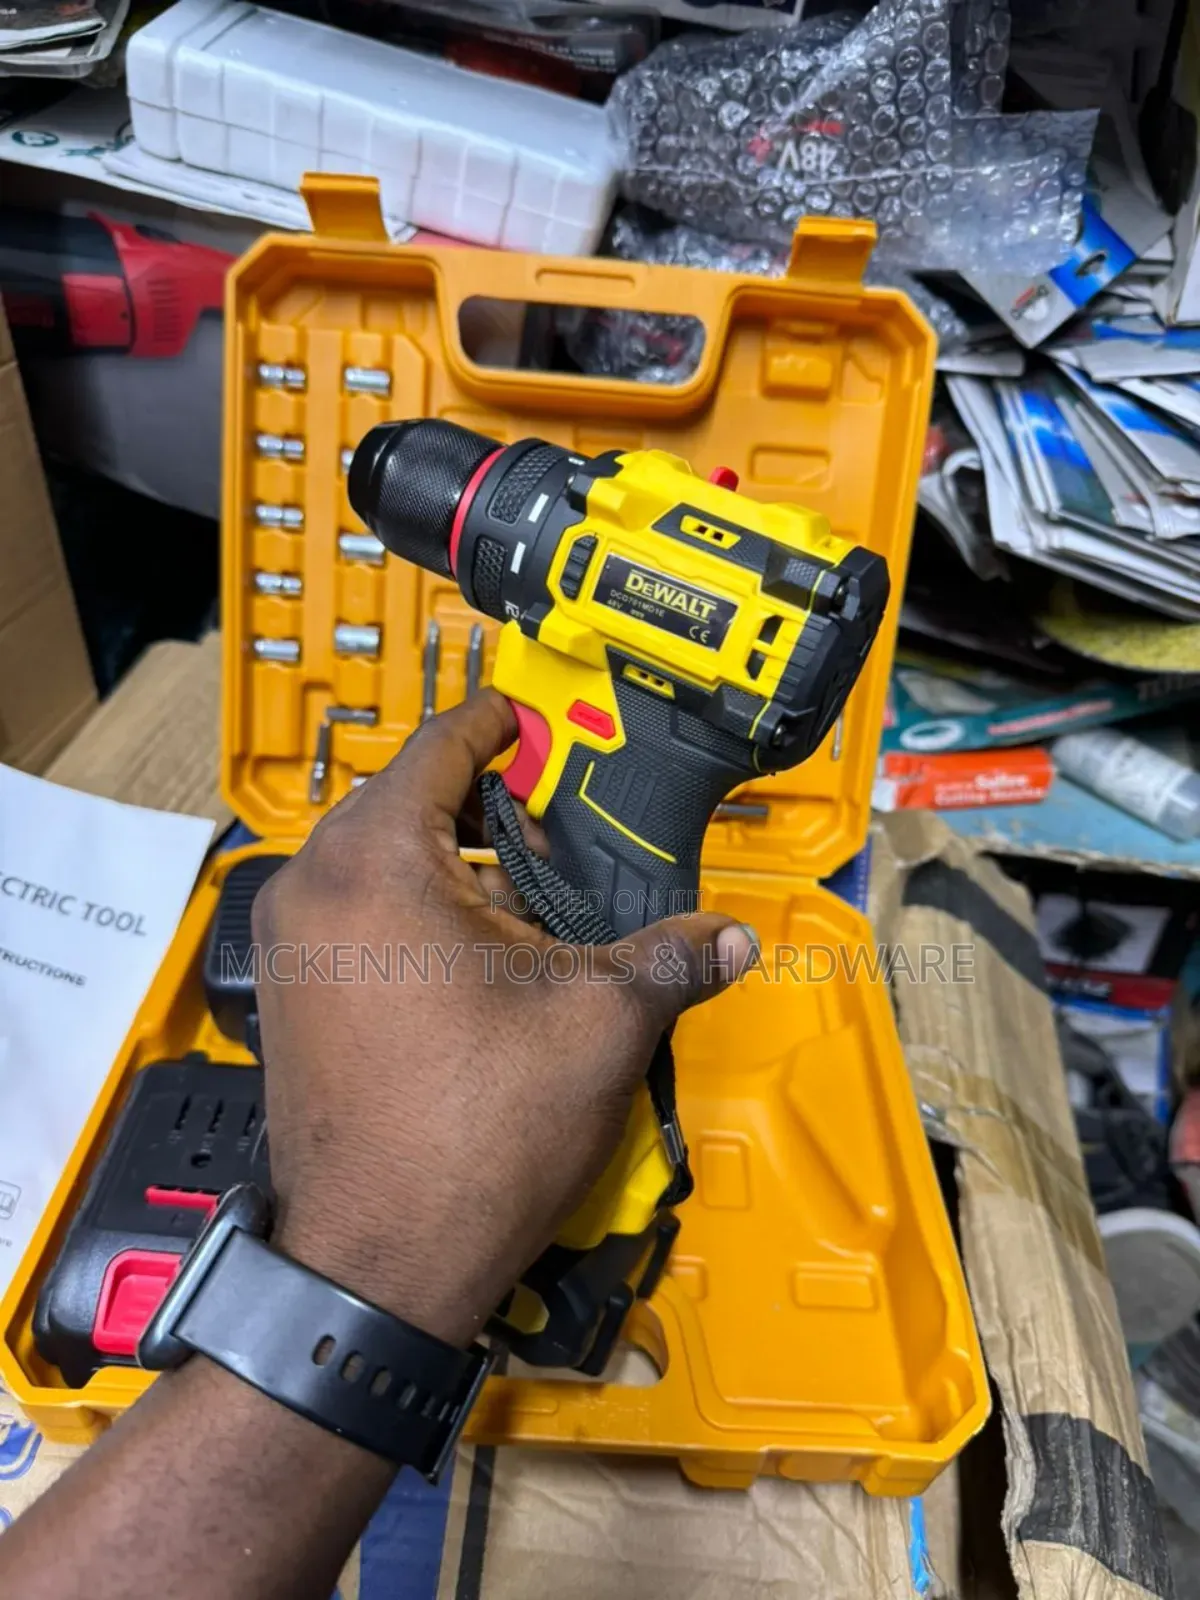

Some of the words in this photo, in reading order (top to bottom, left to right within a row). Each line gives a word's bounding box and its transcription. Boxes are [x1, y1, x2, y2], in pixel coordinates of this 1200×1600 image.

[775, 140, 838, 180] 48V
[0, 872, 77, 916] CTRIC
[81, 901, 148, 937] TOOL
